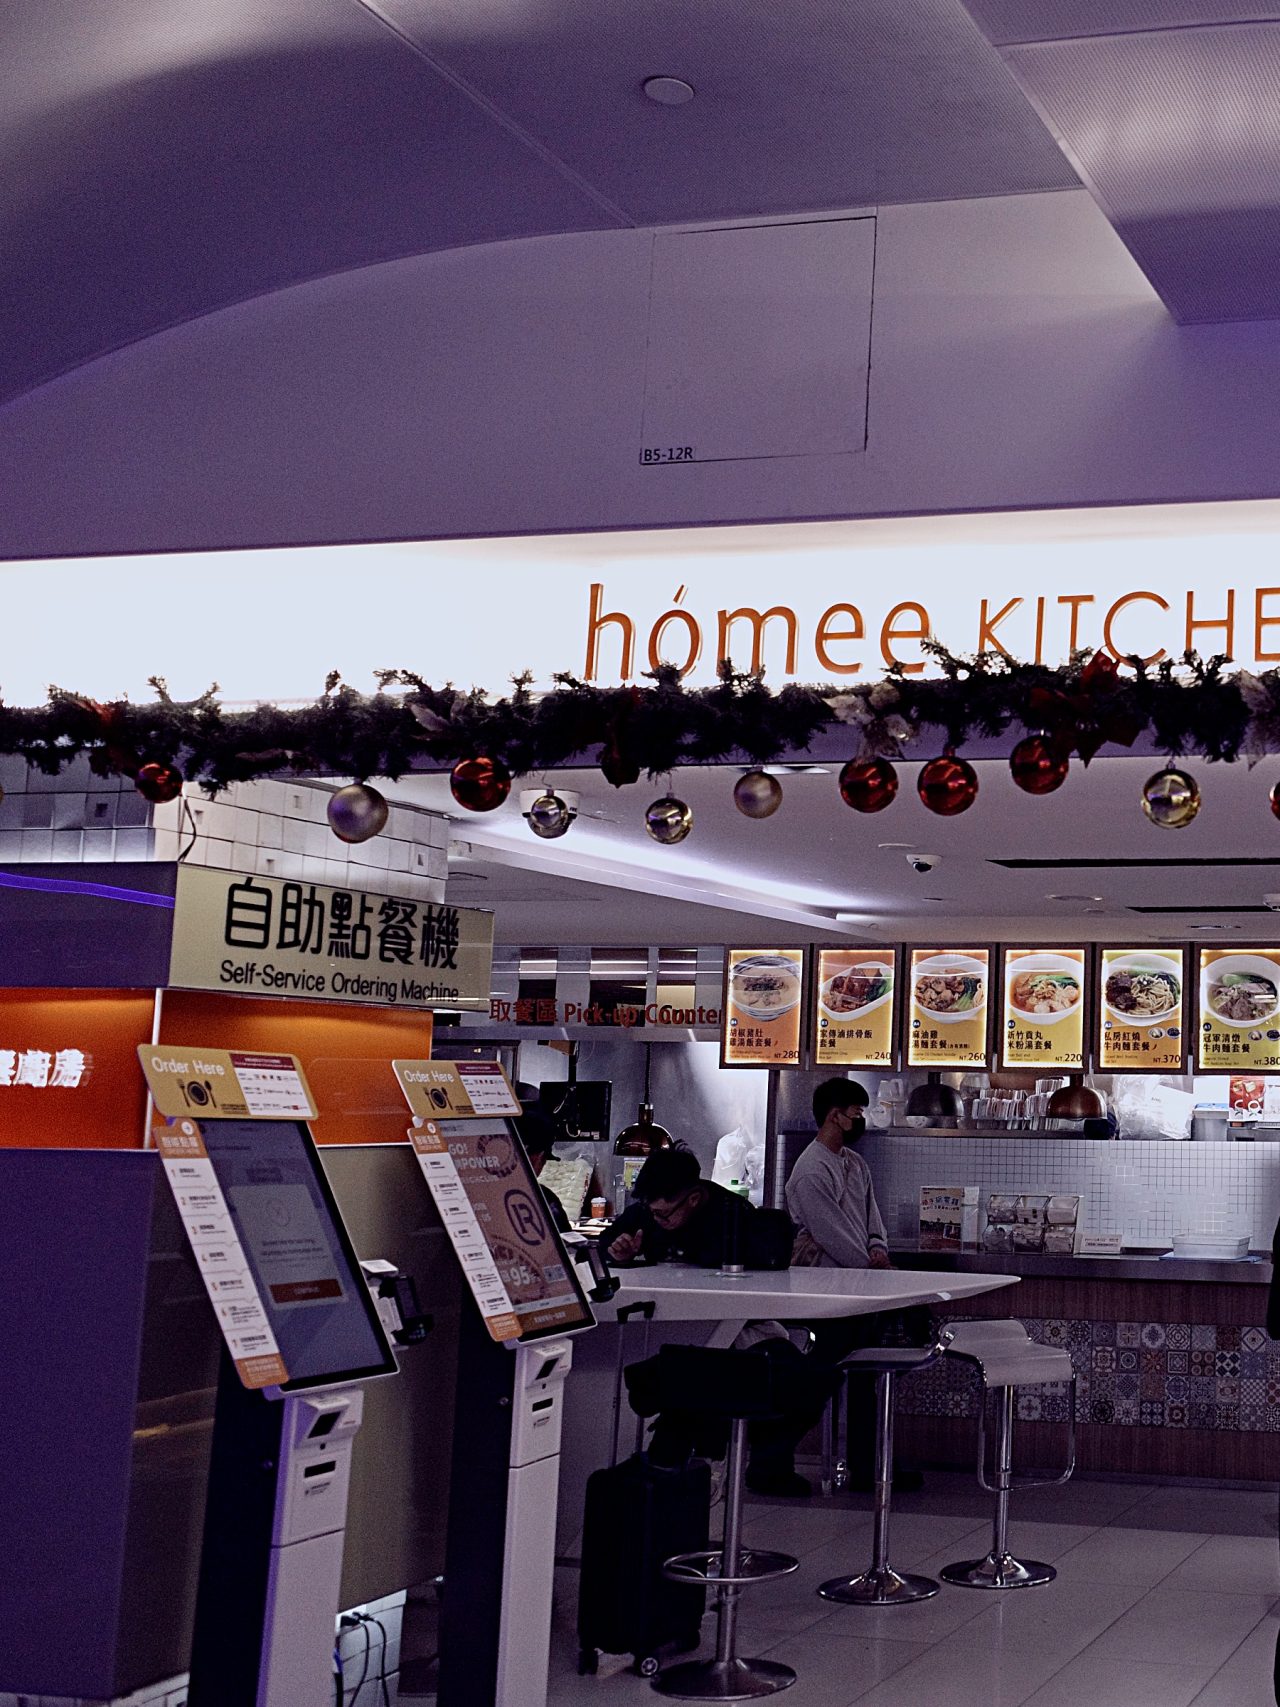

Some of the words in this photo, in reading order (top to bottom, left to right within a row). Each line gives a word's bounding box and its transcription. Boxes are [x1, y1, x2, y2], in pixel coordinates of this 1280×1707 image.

[644, 447, 693, 461] B5-12R
[225, 877, 460, 971] 自助點餐機
[220, 960, 325, 992] Self-Service
[331, 972, 397, 1002] Ordering
[401, 979, 459, 1003] Machine
[489, 998, 557, 1025] 取餐區
[564, 1003, 639, 1028] Pick-up
[1203, 1043, 1250, 1053] 牛肉麵套餐
[152, 1057, 189, 1073] Order
[192, 1060, 225, 1076] Here
[404, 1070, 430, 1082] Order
[431, 1071, 455, 1083] Here
